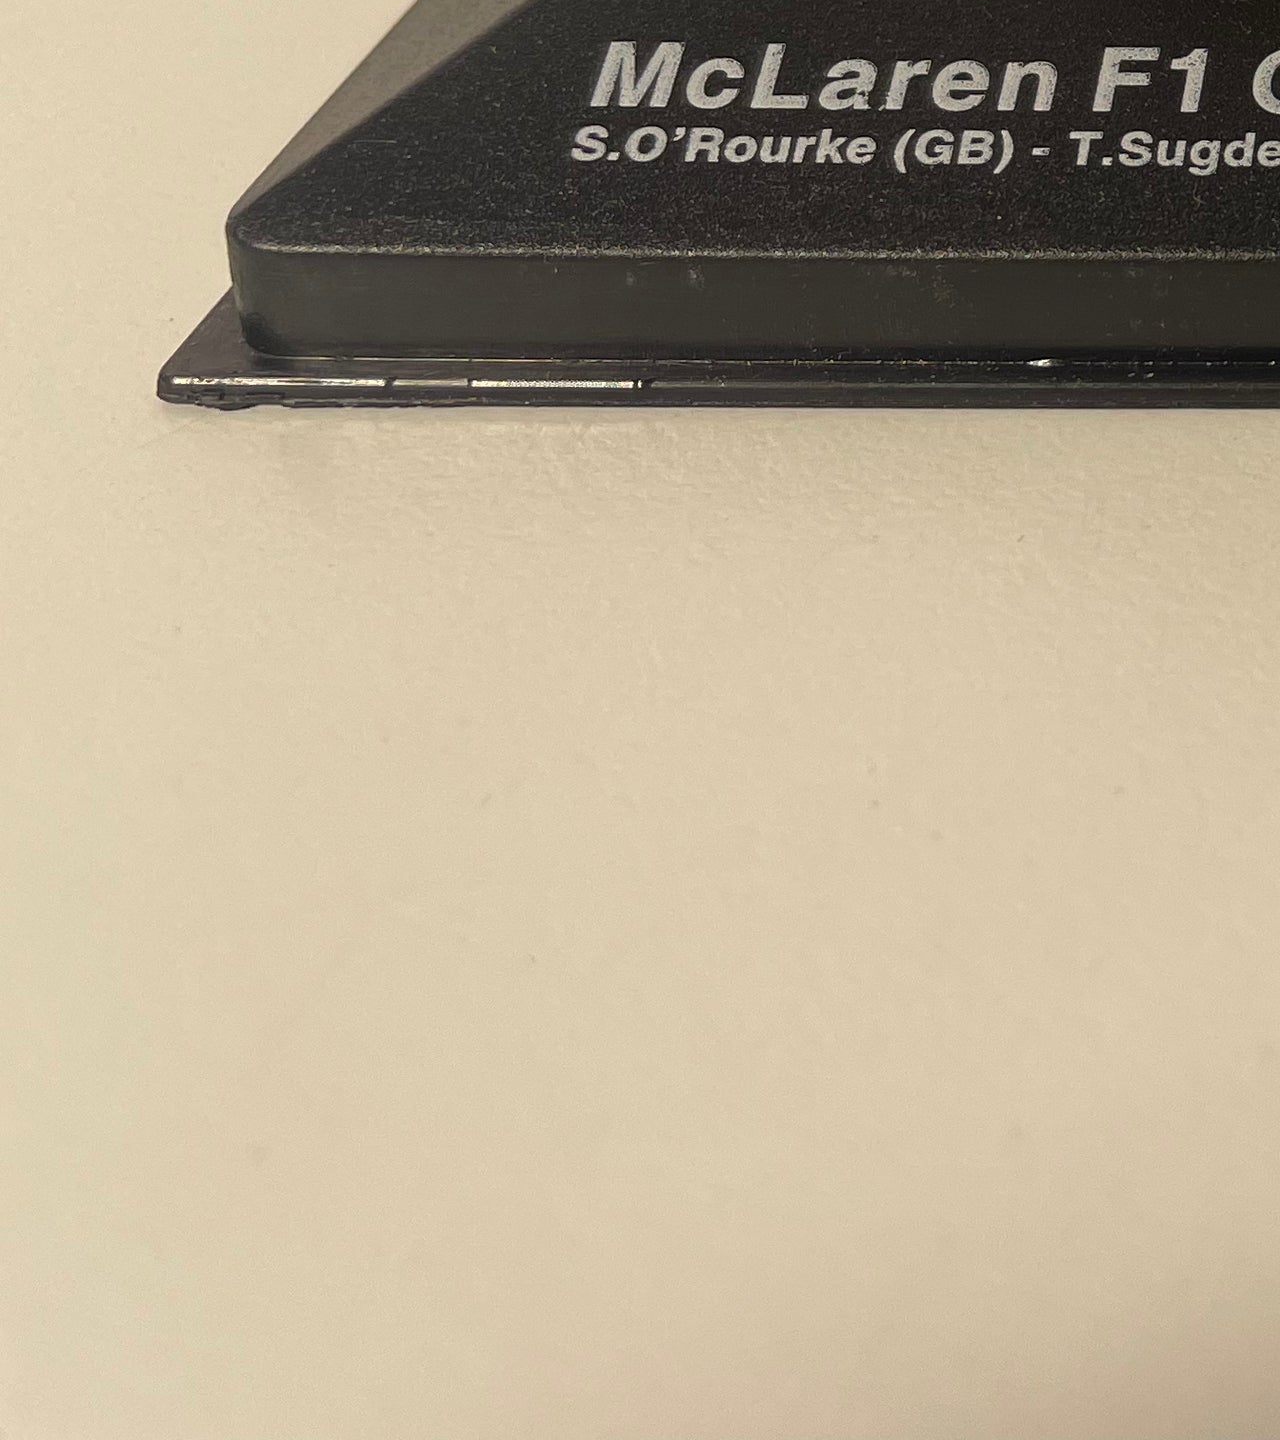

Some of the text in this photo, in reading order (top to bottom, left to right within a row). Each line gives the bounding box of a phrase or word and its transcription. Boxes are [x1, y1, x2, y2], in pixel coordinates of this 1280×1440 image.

[589, 40, 1059, 113] McLaren
[1092, 46, 1210, 114] F1
[570, 123, 879, 164] S.O'Rourke
[892, 126, 1015, 174] (GB)
